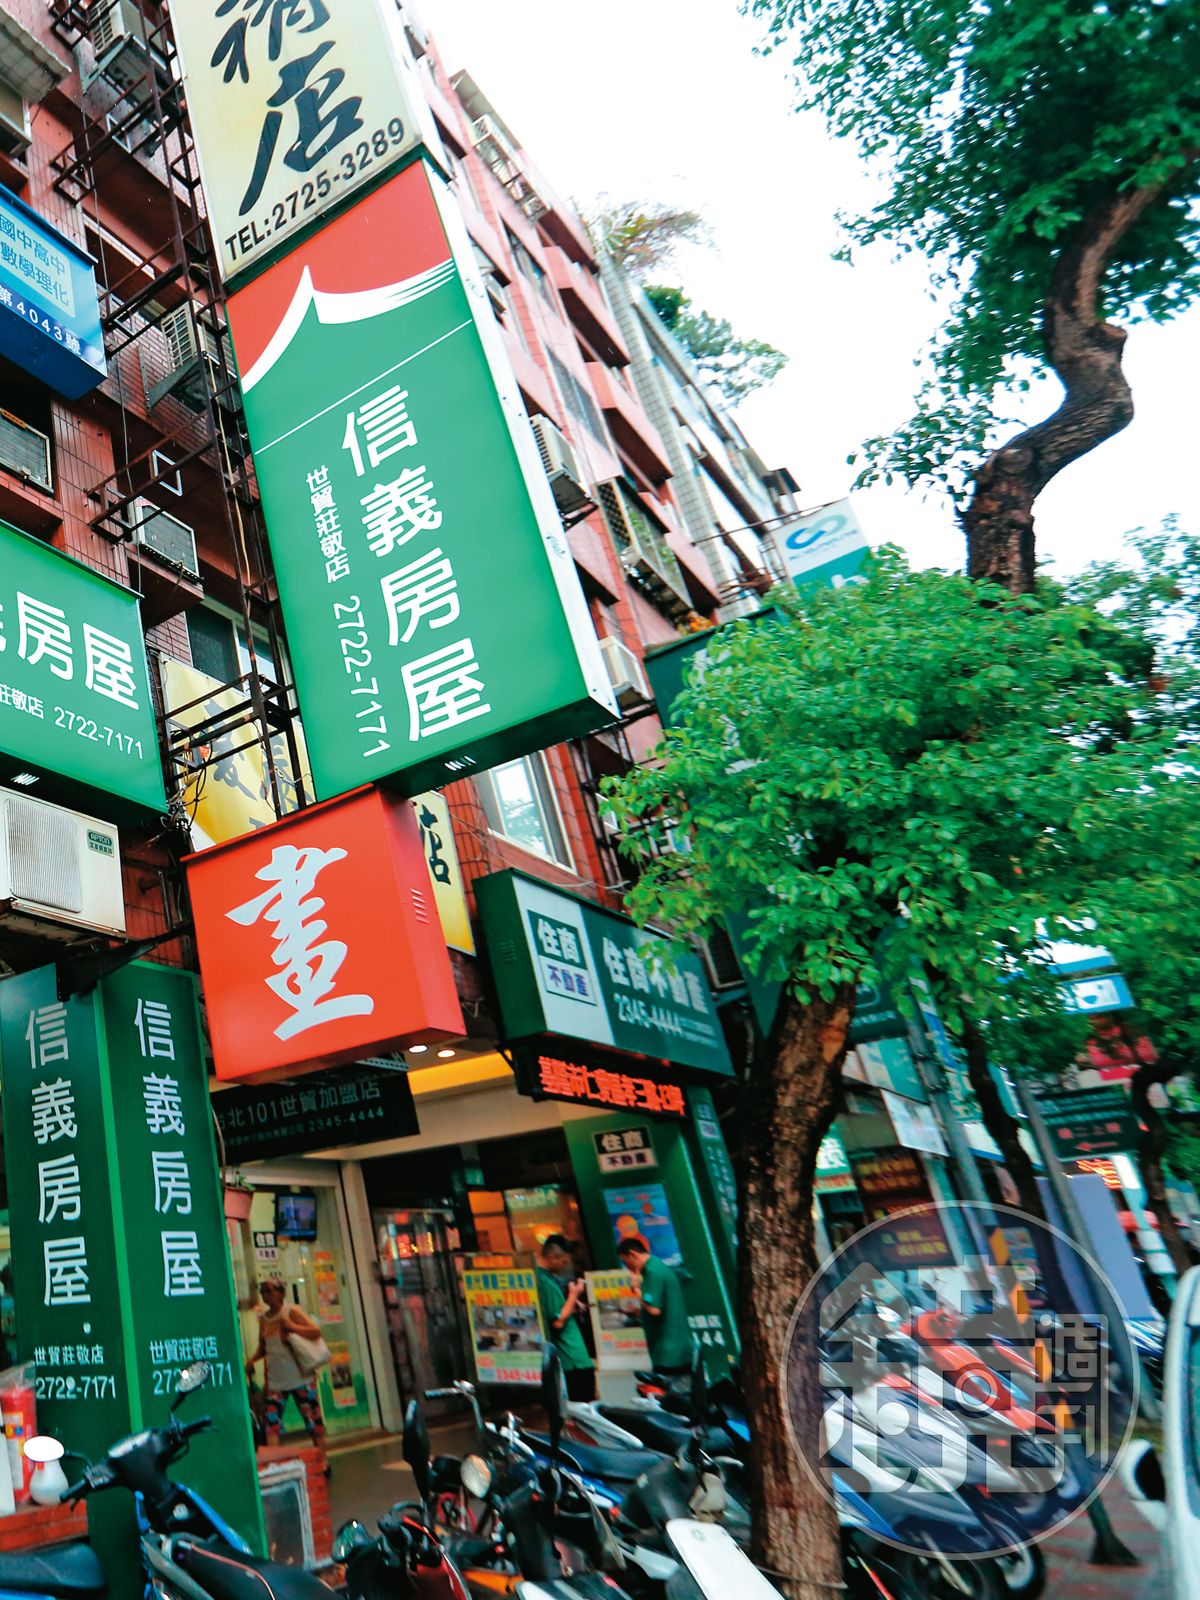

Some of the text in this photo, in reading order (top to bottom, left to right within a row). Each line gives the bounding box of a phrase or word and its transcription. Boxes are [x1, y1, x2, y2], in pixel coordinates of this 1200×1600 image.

[225, 117, 405, 261] TEL:2725-3289
[341, 384, 492, 743] 信義房屋
[305, 464, 391, 758] 世貿莊敬店 2722-7171
[53, 706, 144, 760] 2722-7171
[225, 845, 374, 1042] 畫
[537, 917, 581, 964] 住商
[24, 1001, 91, 1307] 信義房屋
[134, 998, 205, 1298] 信義房屋
[602, 1130, 643, 1150] 住商
[34, 1343, 104, 1366] 世貿莊敬店
[150, 1335, 218, 1365] 世貿莊敬店
[35, 1375, 117, 1400] 2722-7171
[152, 1362, 234, 1396] 27171
